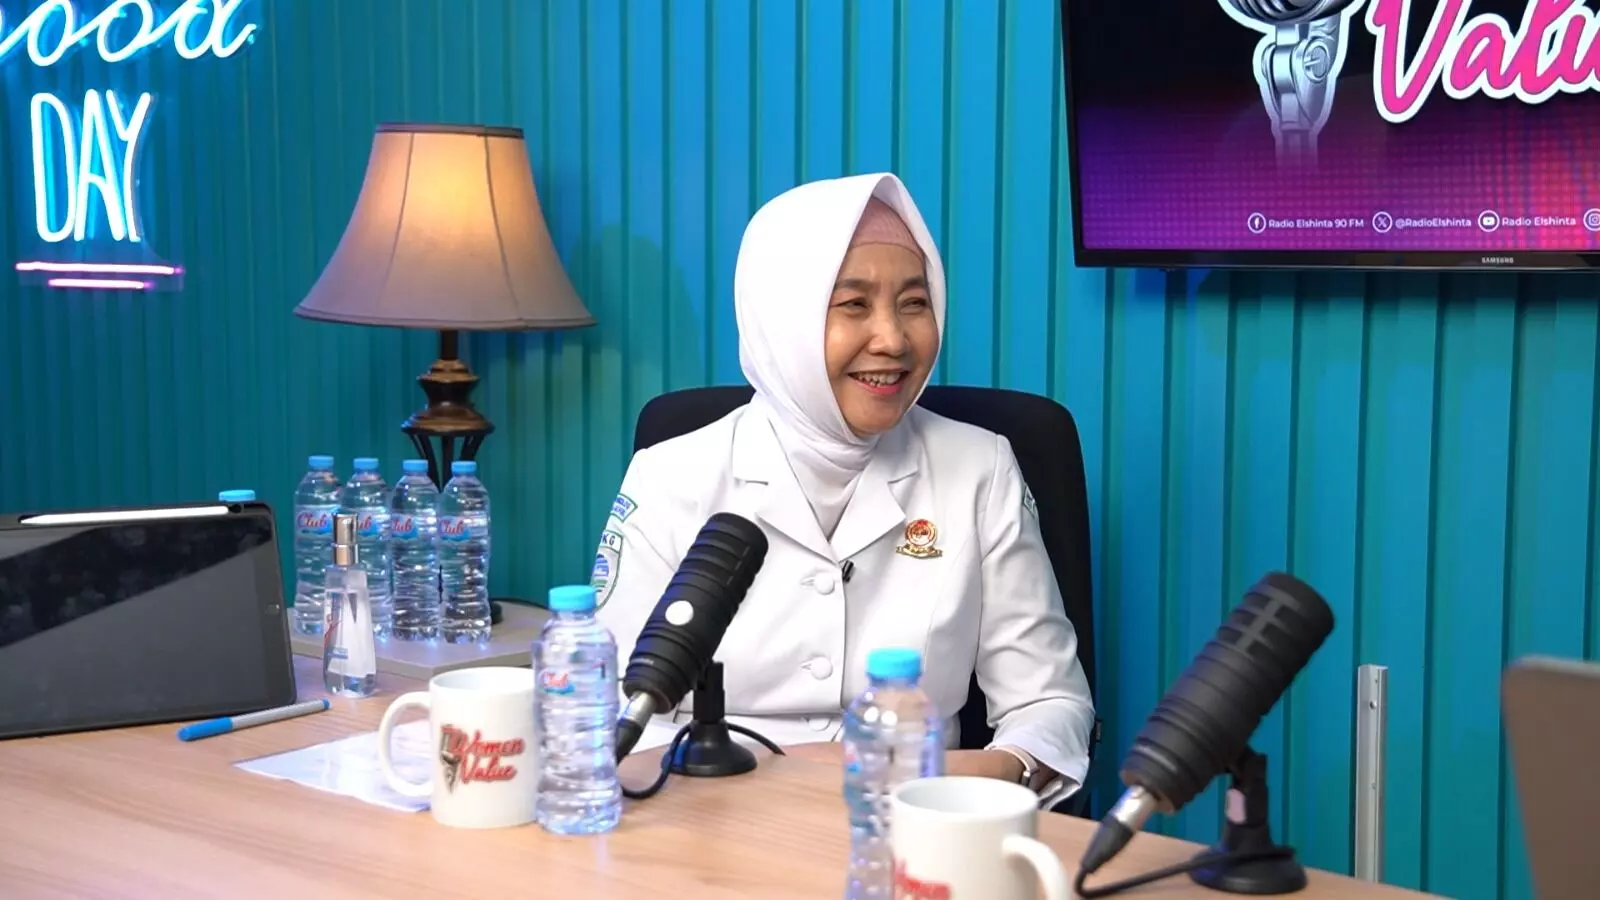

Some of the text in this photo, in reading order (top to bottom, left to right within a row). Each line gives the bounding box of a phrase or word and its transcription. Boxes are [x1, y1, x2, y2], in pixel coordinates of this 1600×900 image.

[0, 0, 257, 66] ood
[31, 89, 151, 242] DAY
[1268, 218, 1365, 229] Radio Elshinta 90 FM
[1395, 216, 1472, 229] @RadioElshinta
[1502, 216, 1577, 227] Radio Elshinta
[297, 512, 327, 528] Club
[442, 727, 526, 756] Women
[460, 753, 518, 784] Value
